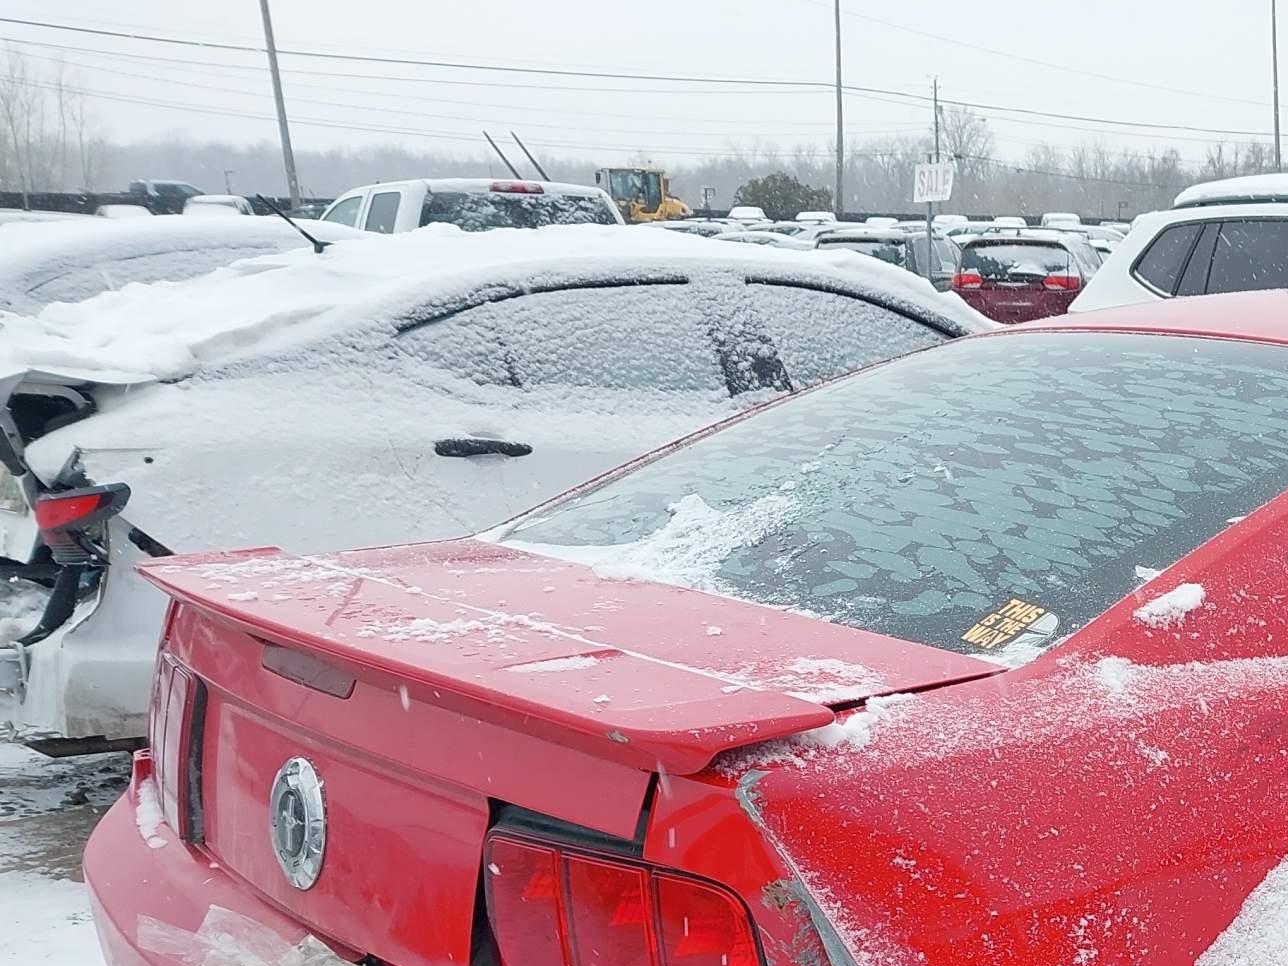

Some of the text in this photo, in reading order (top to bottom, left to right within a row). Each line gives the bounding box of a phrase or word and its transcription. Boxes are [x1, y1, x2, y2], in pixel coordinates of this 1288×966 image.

[918, 168, 951, 198] SALE
[979, 612, 1027, 636] IS THE
[997, 598, 1046, 624] THIS
[960, 622, 1013, 649] WAY
